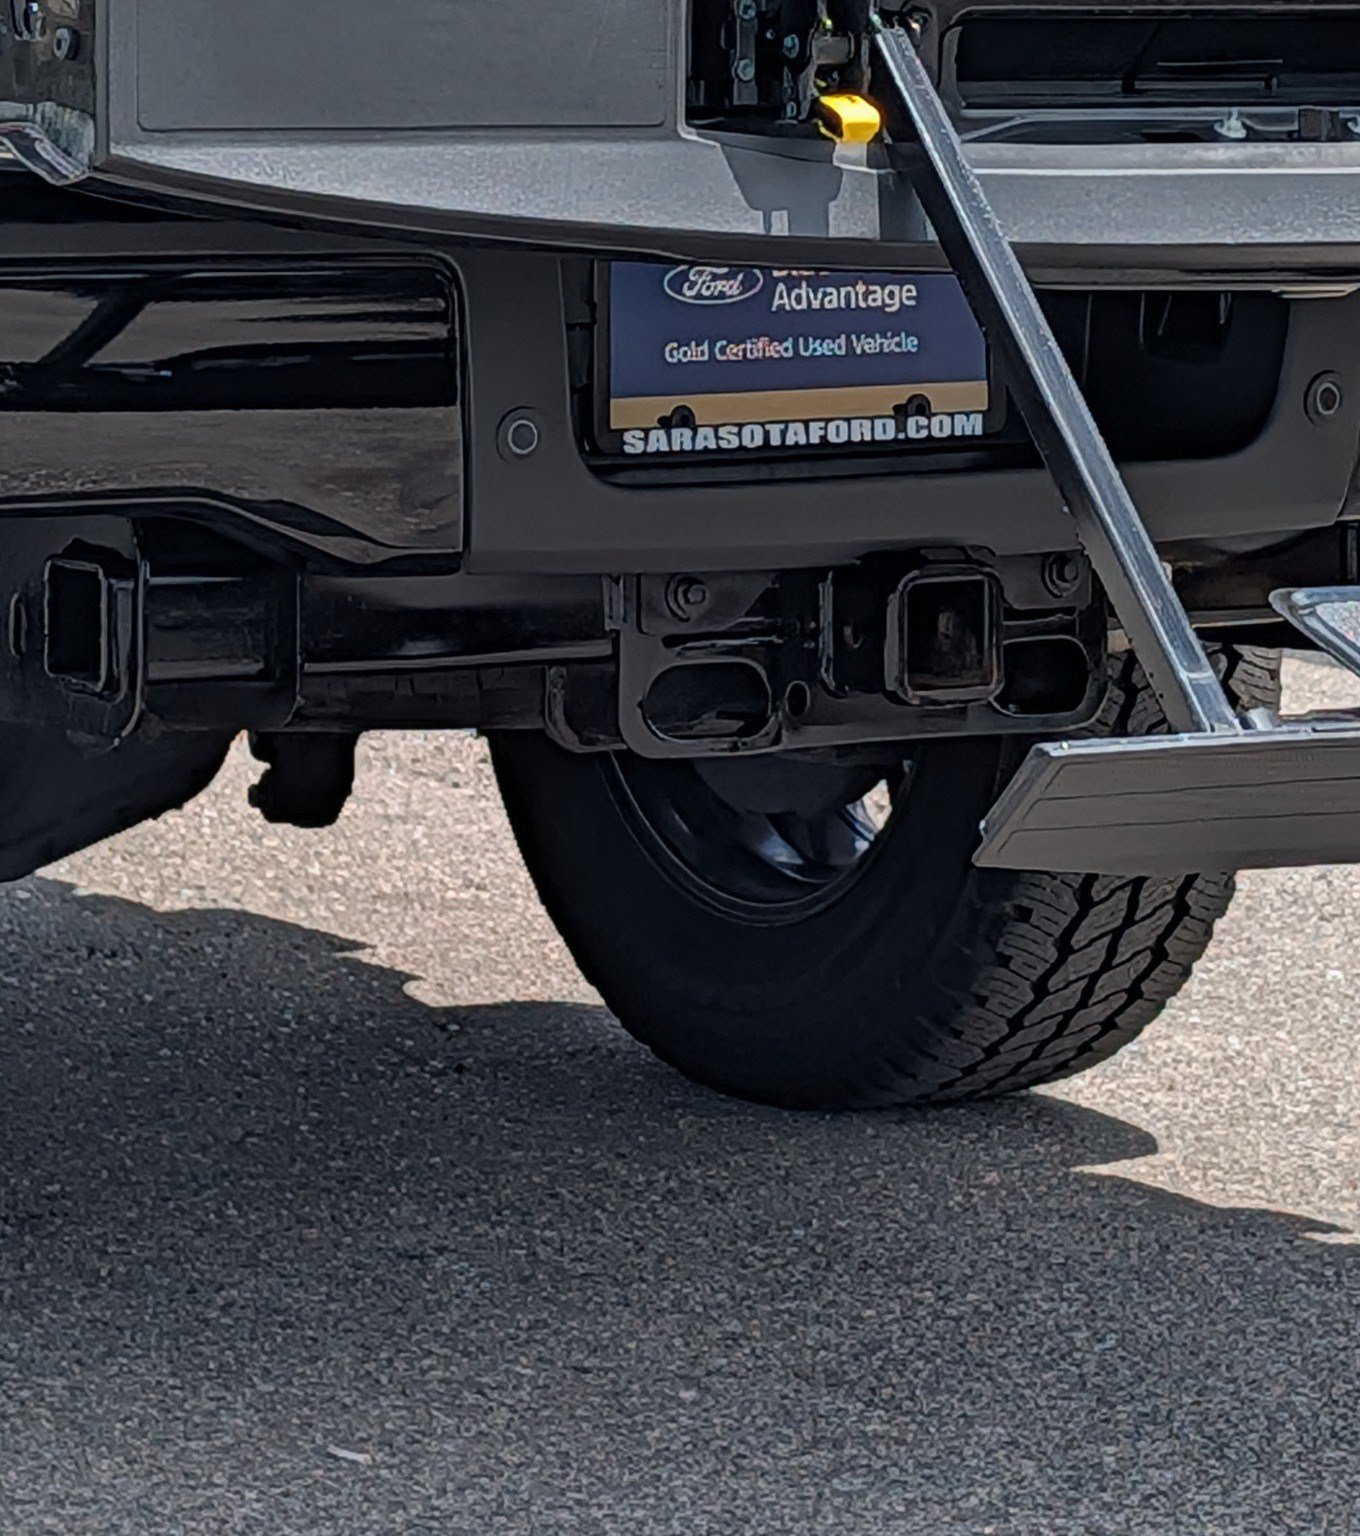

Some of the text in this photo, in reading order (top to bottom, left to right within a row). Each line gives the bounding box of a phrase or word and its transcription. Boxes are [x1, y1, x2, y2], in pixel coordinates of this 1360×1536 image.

[681, 265, 744, 298] Ford
[771, 279, 918, 313] Advantage
[664, 330, 920, 364] Gold Certified Used Vehicle
[623, 412, 984, 454] SARASOTAFORD.COM
